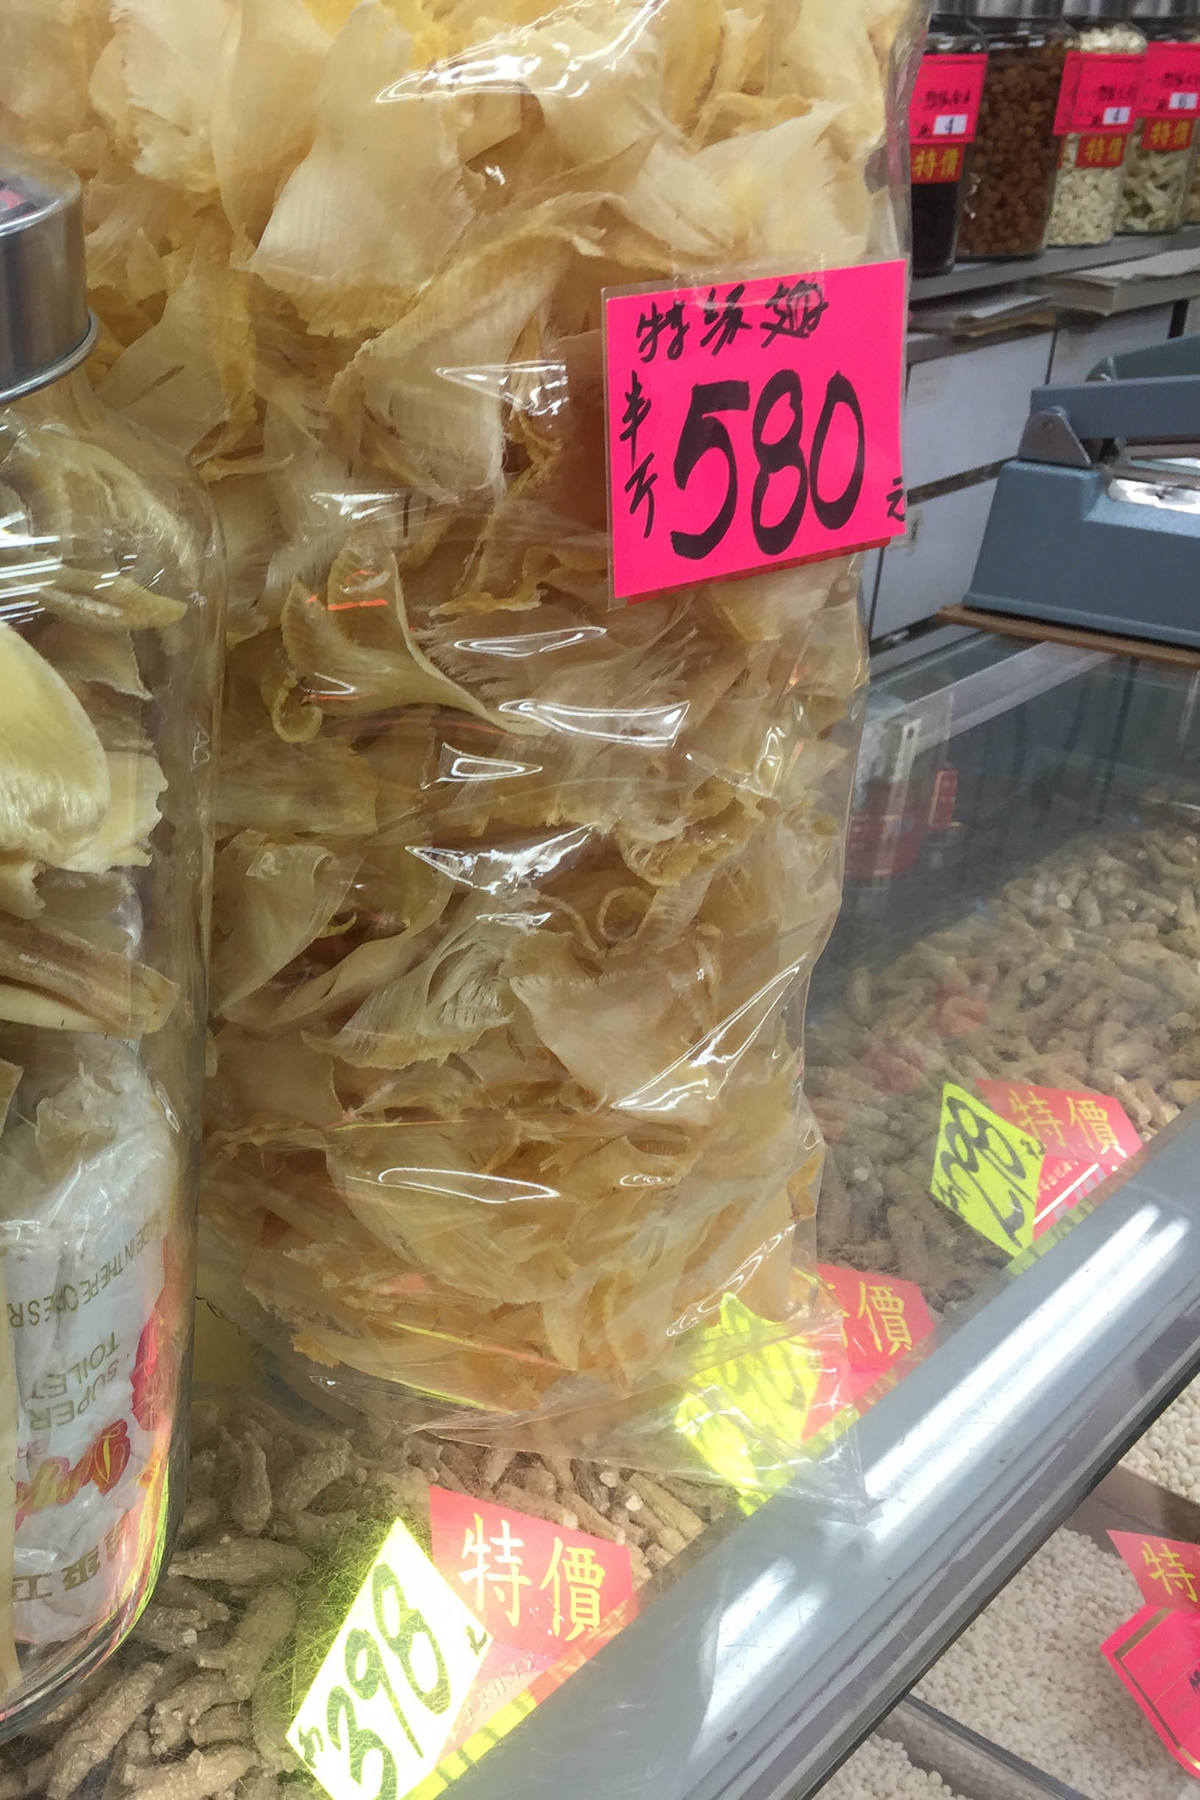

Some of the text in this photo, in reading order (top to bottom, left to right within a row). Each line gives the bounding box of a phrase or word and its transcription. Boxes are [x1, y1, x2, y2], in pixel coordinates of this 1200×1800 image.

[913, 147, 960, 177] 特價
[670, 368, 866, 561] 580
[939, 1095, 1037, 1250] 298
[1008, 1088, 1129, 1159] 特價
[25, 1330, 121, 1401] TOILET
[29, 1357, 120, 1431] SUPER
[457, 1512, 607, 1643] 特價
[325, 1561, 452, 1800] 398
